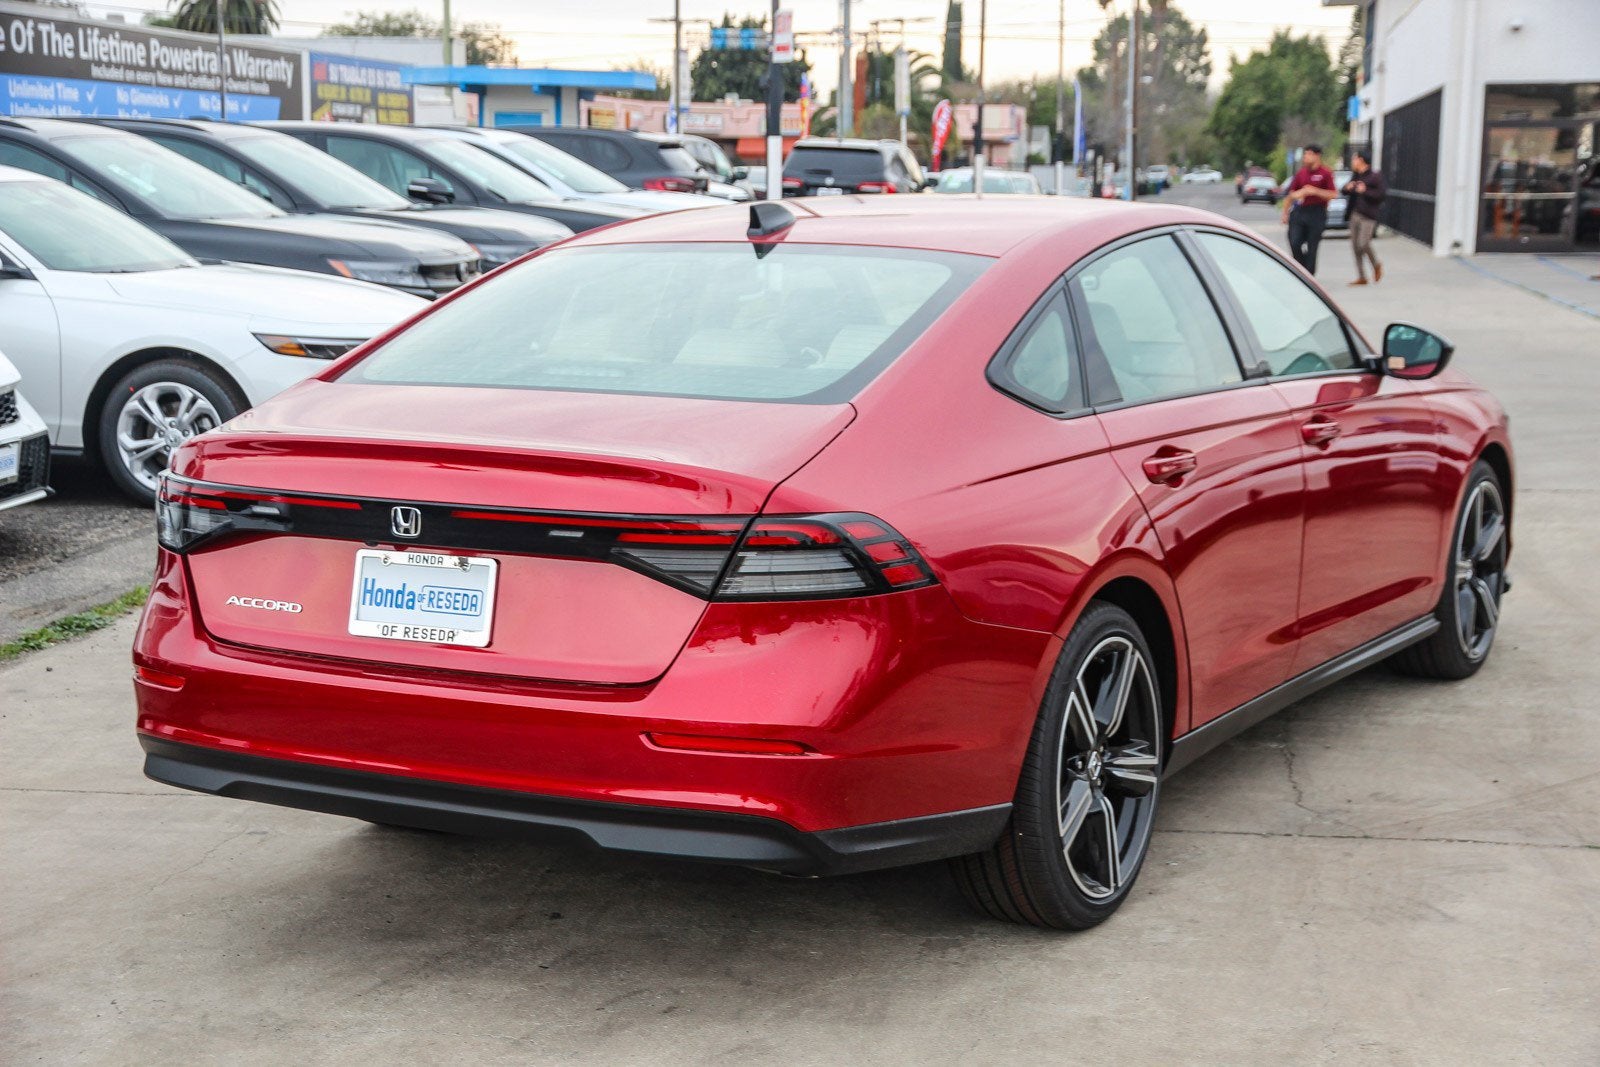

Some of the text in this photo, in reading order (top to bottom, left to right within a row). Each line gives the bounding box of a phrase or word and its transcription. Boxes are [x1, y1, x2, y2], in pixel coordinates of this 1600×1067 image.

[9, 18, 35, 54] Of
[37, 21, 75, 58] The
[78, 26, 147, 66] Lifetime
[233, 47, 294, 88] Warranty
[8, 78, 79, 102] Unlimited Time
[407, 554, 444, 566] HONDA
[225, 595, 303, 614] ACCORD
[361, 577, 417, 611] Honda
[427, 590, 479, 613] RESEDA
[381, 625, 456, 643] OF RESEDA
